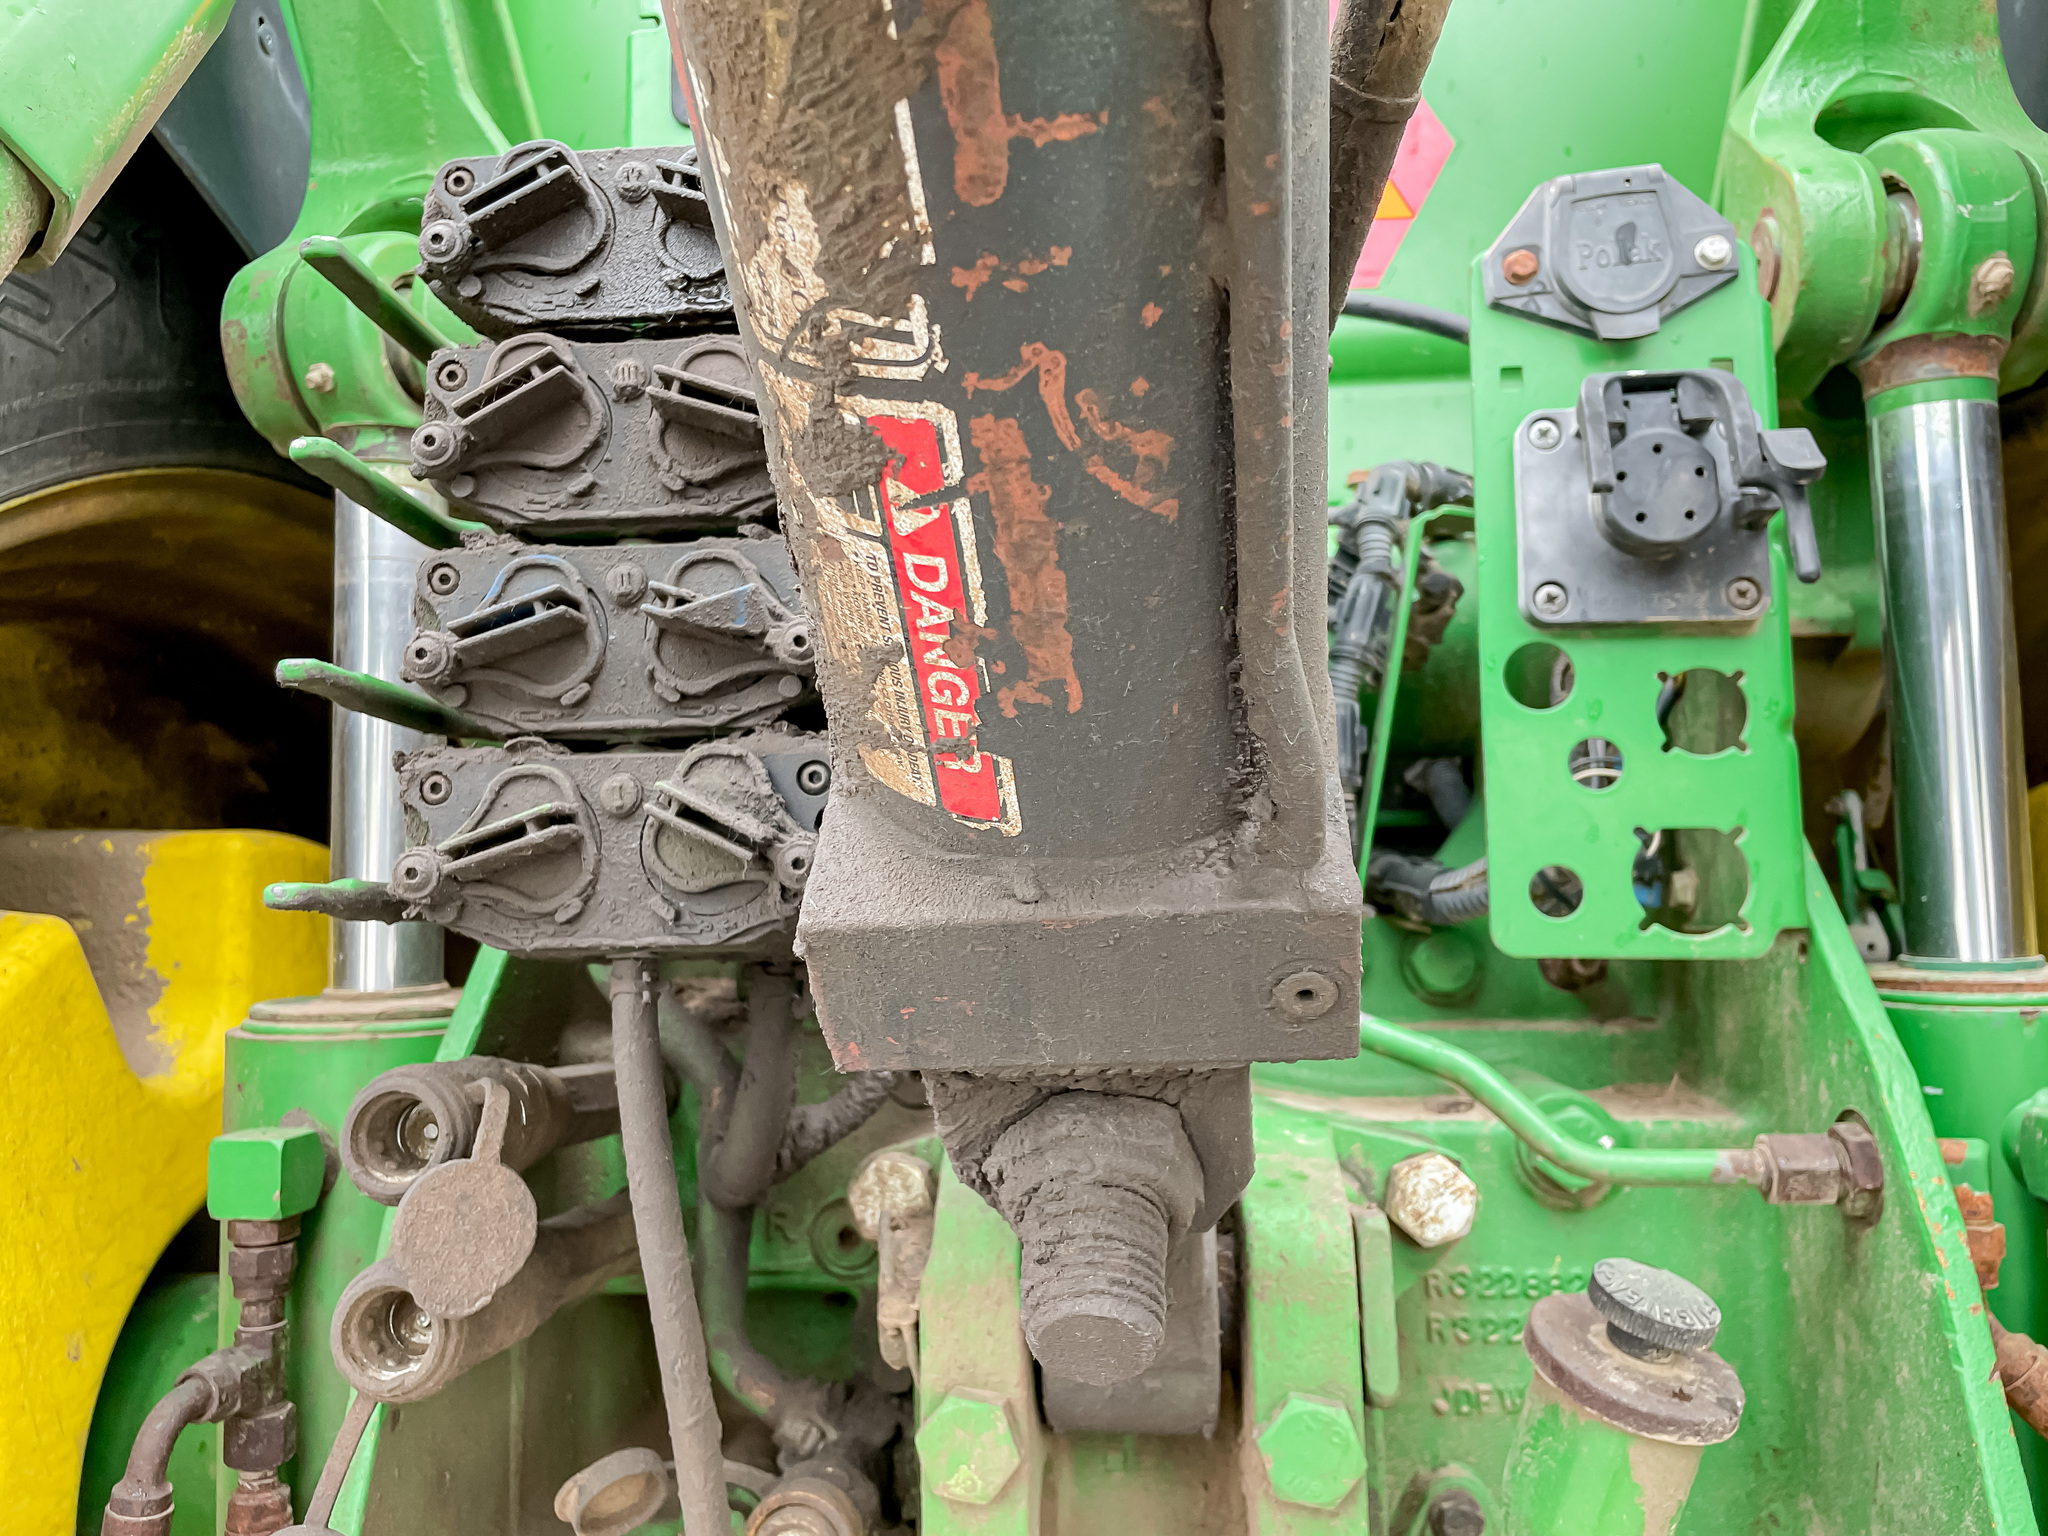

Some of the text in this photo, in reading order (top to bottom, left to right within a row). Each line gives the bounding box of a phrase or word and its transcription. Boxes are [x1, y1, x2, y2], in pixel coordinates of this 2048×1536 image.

[853, 560, 865, 589] KEEP
[865, 555, 878, 571] TO
[869, 574, 892, 633] PREVENT
[883, 635, 902, 687] SOUS
[903, 552, 984, 774] DANGER
[895, 689, 913, 732] INJURY
